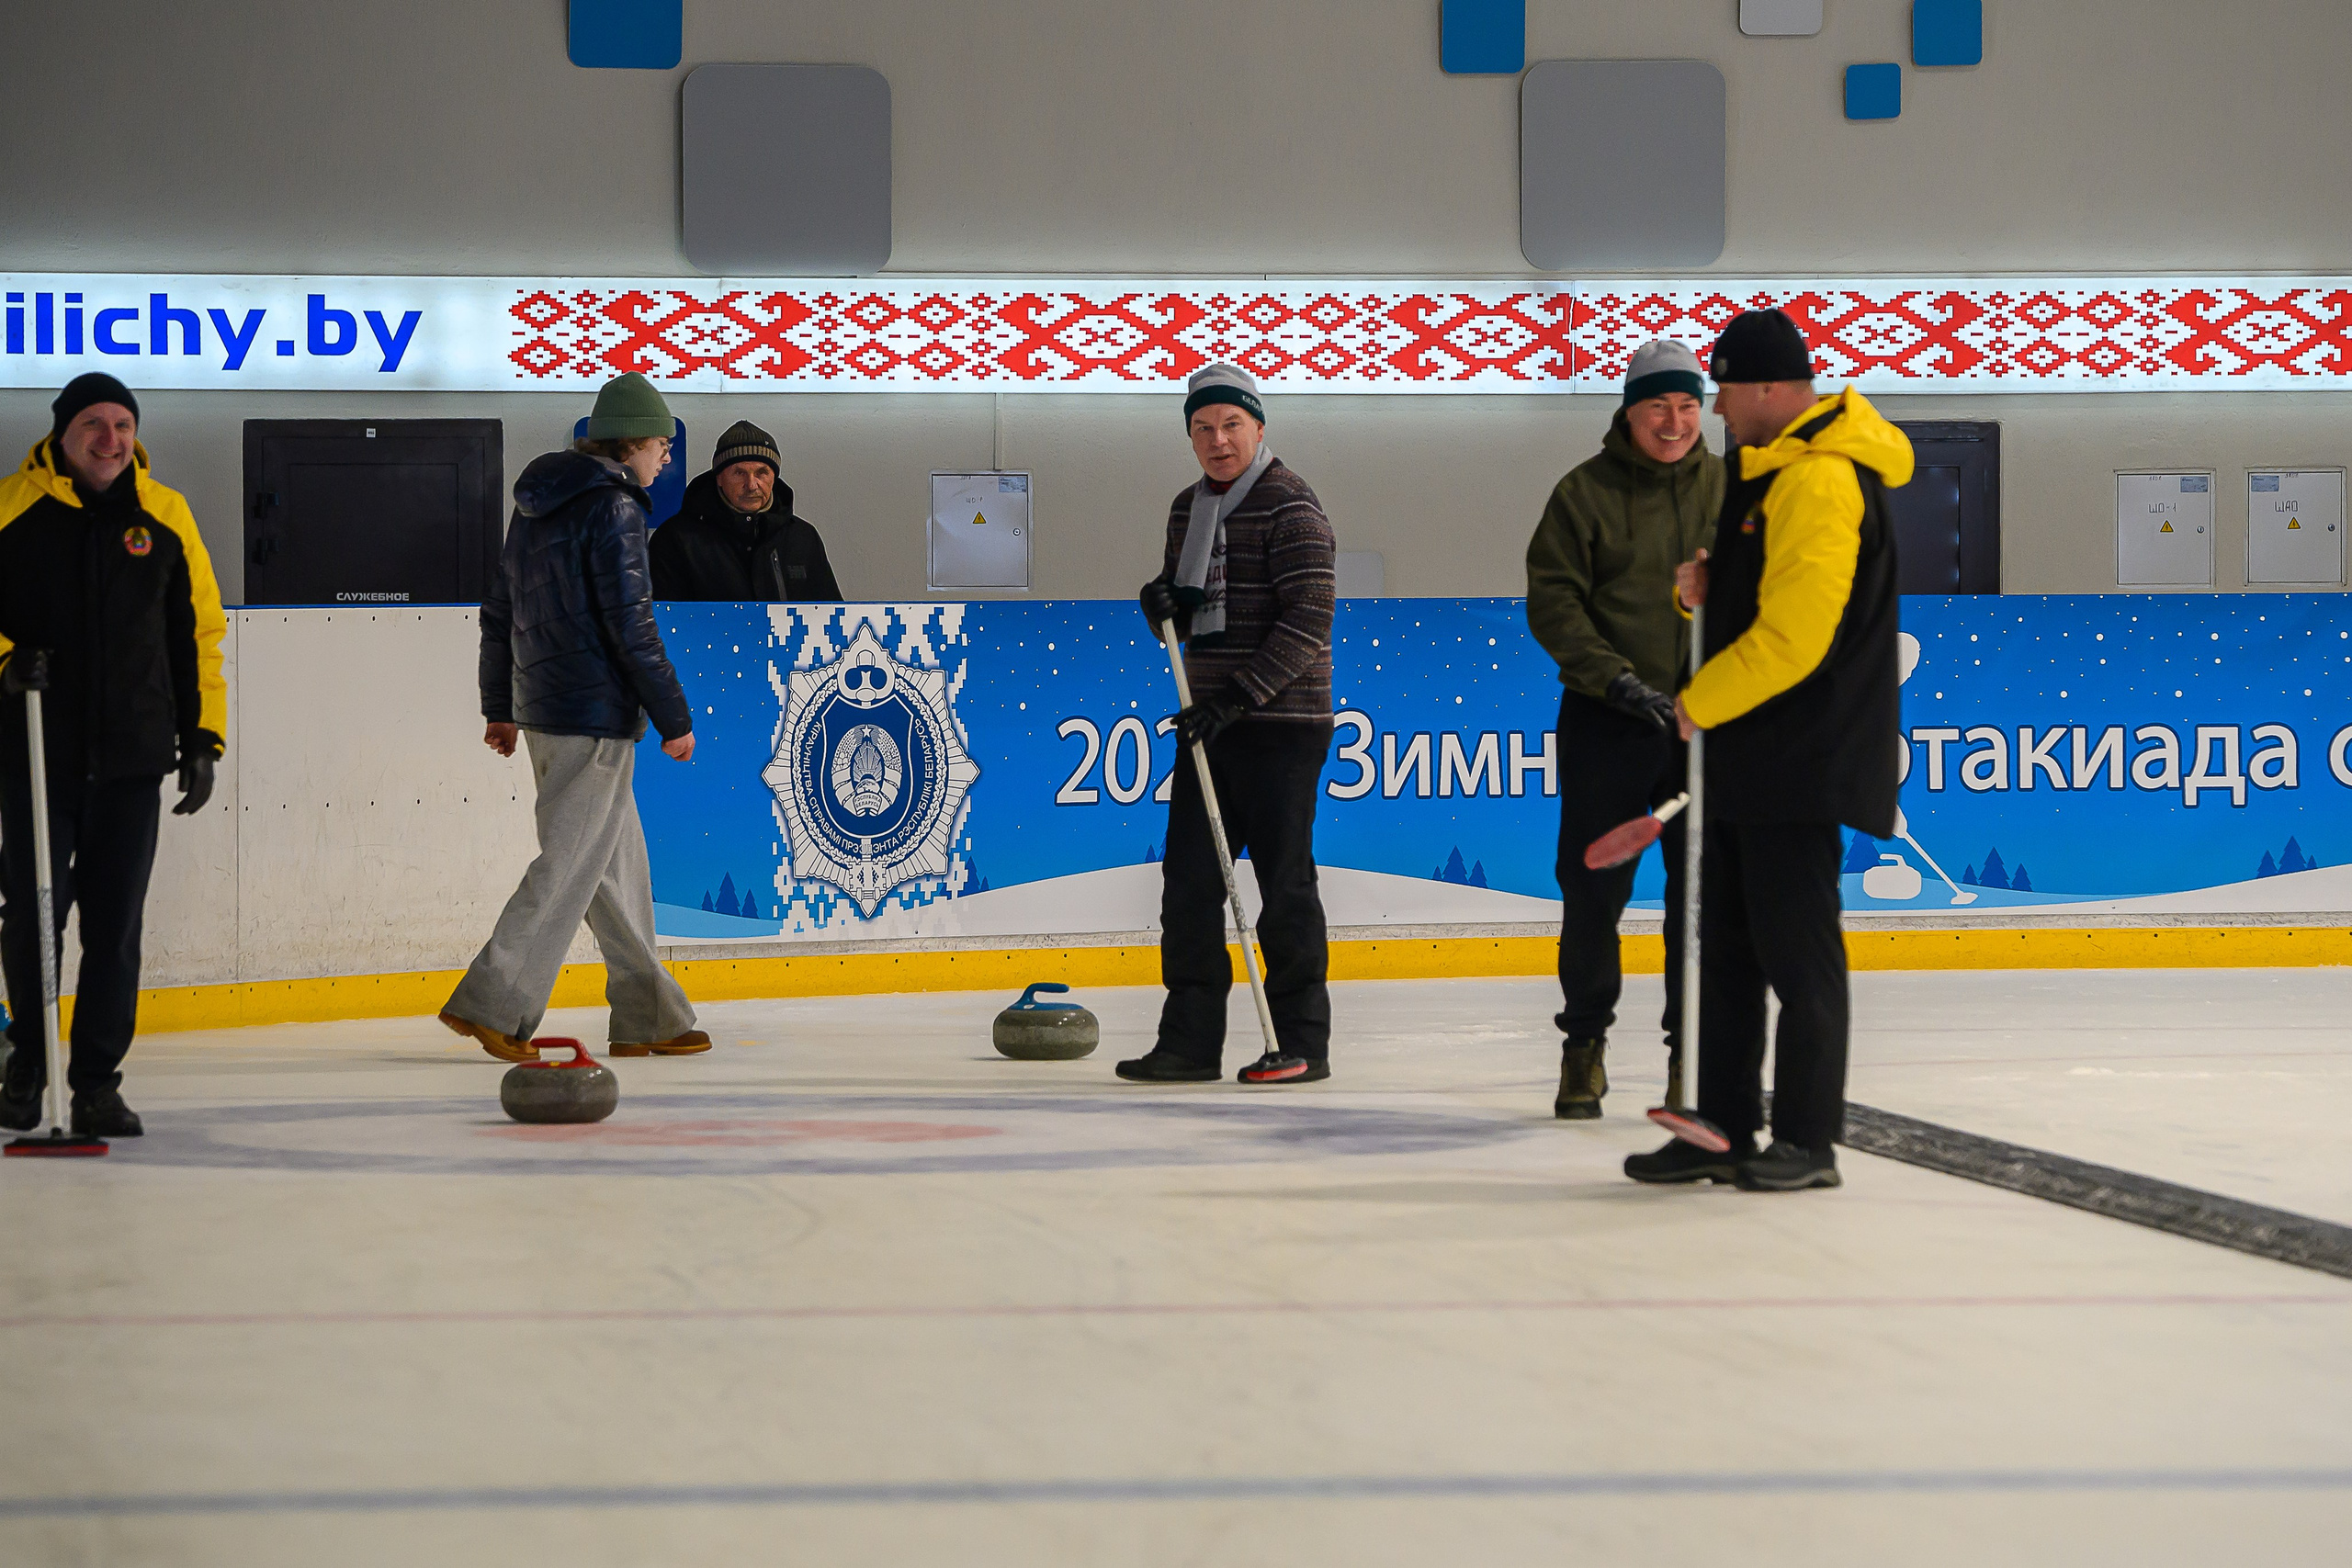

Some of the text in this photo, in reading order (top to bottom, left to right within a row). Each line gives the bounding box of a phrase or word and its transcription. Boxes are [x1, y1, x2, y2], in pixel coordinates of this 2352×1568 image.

[6, 292, 424, 372] ilichy.by
[1242, 395, 1263, 413] БЕЛА
[336, 592, 410, 601] СЛУЖЕБНОЕ
[809, 796, 842, 845] СПРАВАМІ
[914, 718, 933, 779] БЕЛАРУСЬ
